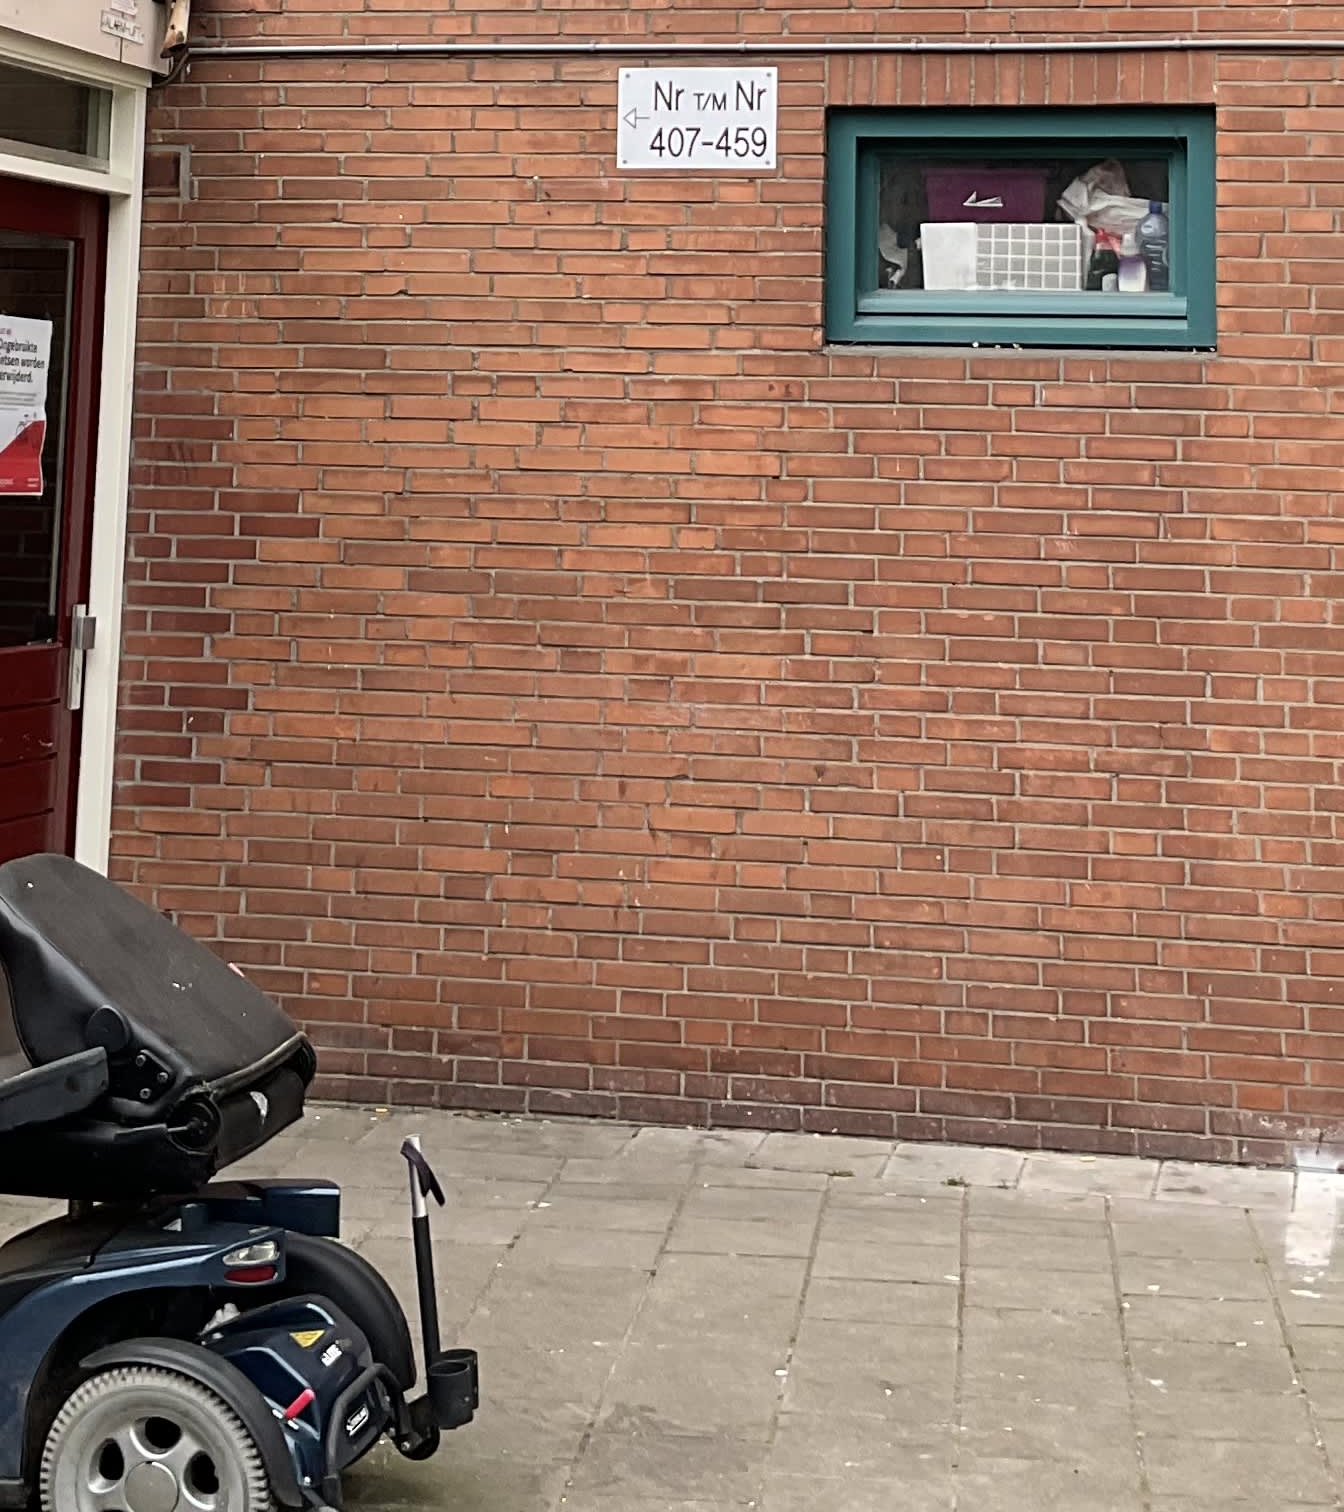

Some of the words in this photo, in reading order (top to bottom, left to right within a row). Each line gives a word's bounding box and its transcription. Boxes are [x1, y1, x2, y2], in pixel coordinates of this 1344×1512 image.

[654, 80, 685, 111] Nr
[693, 92, 727, 111] T/M
[735, 80, 767, 111] Nr
[649, 127, 768, 158] 407-459
[21, 356, 45, 369] worden
